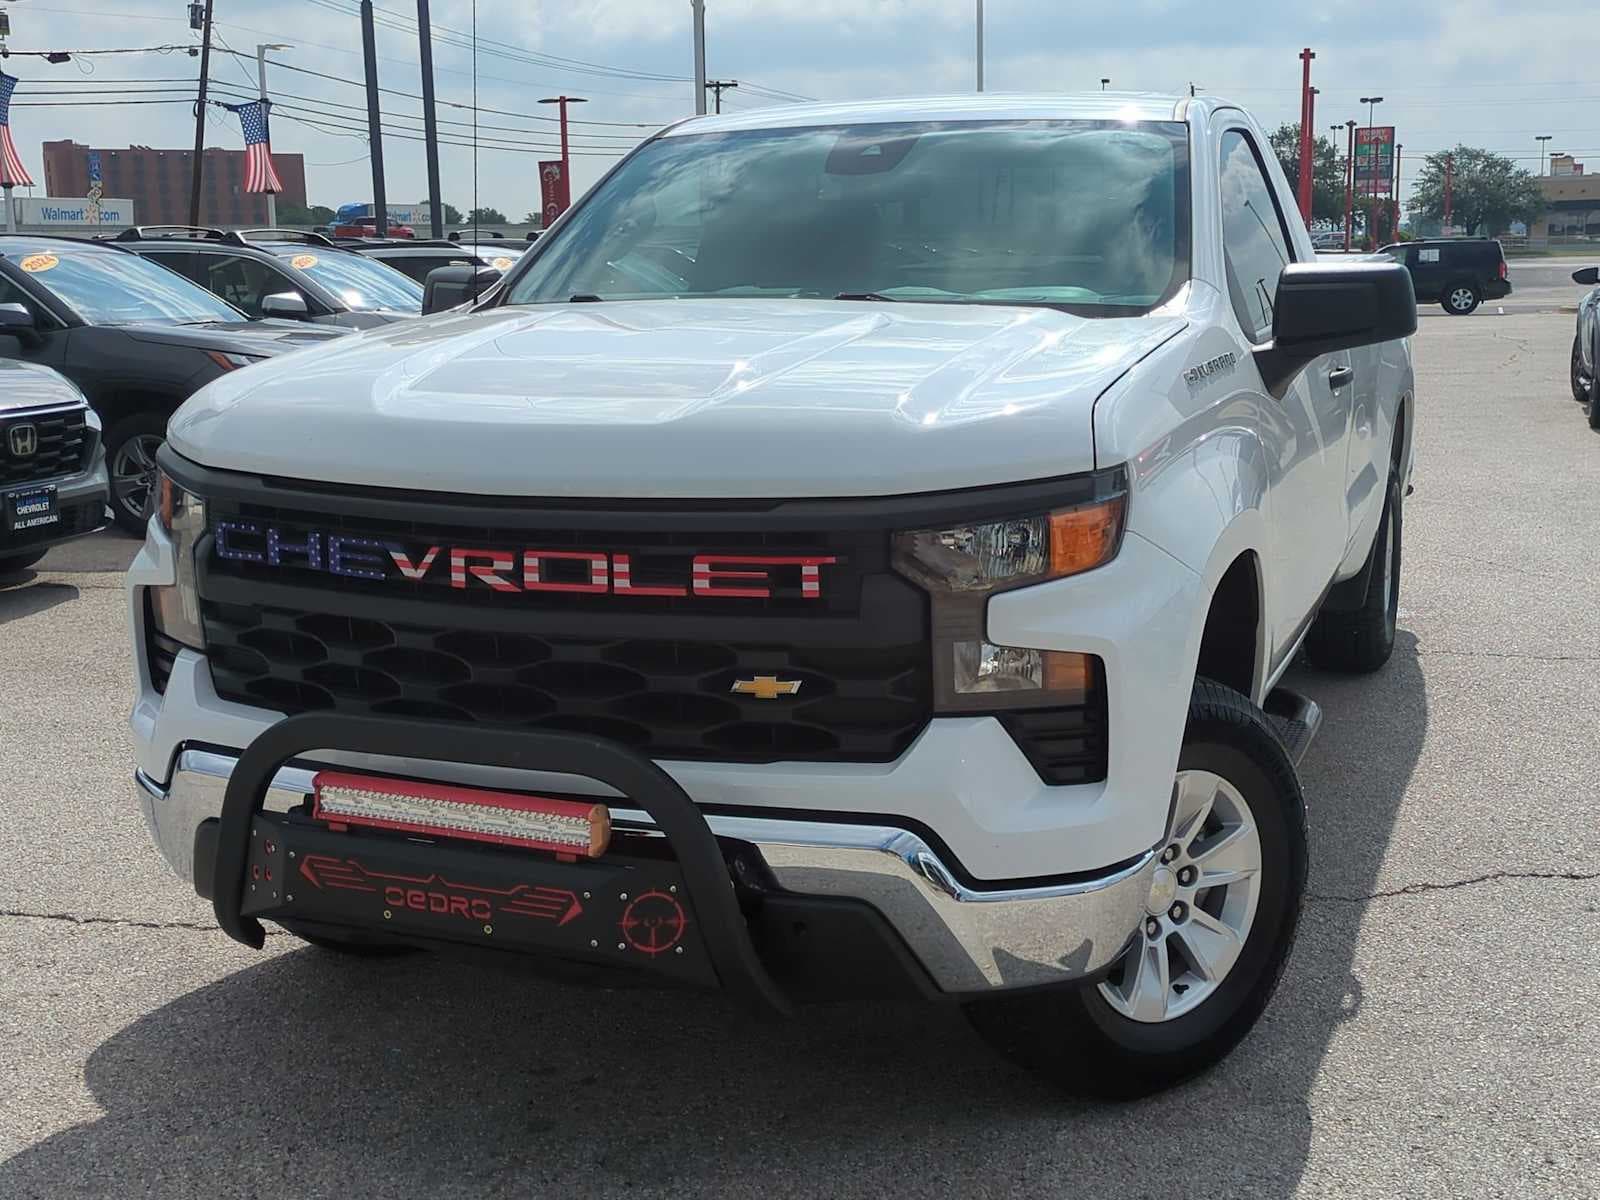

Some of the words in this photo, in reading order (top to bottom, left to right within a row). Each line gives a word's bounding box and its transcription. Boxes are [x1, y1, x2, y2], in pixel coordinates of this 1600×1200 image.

[41, 208, 84, 221] Walmart
[16, 502, 49, 515] CHEVROLET
[14, 521, 26, 530] ALL
[26, 514, 58, 527] AMERICAN
[215, 521, 838, 599] CHEVROLET
